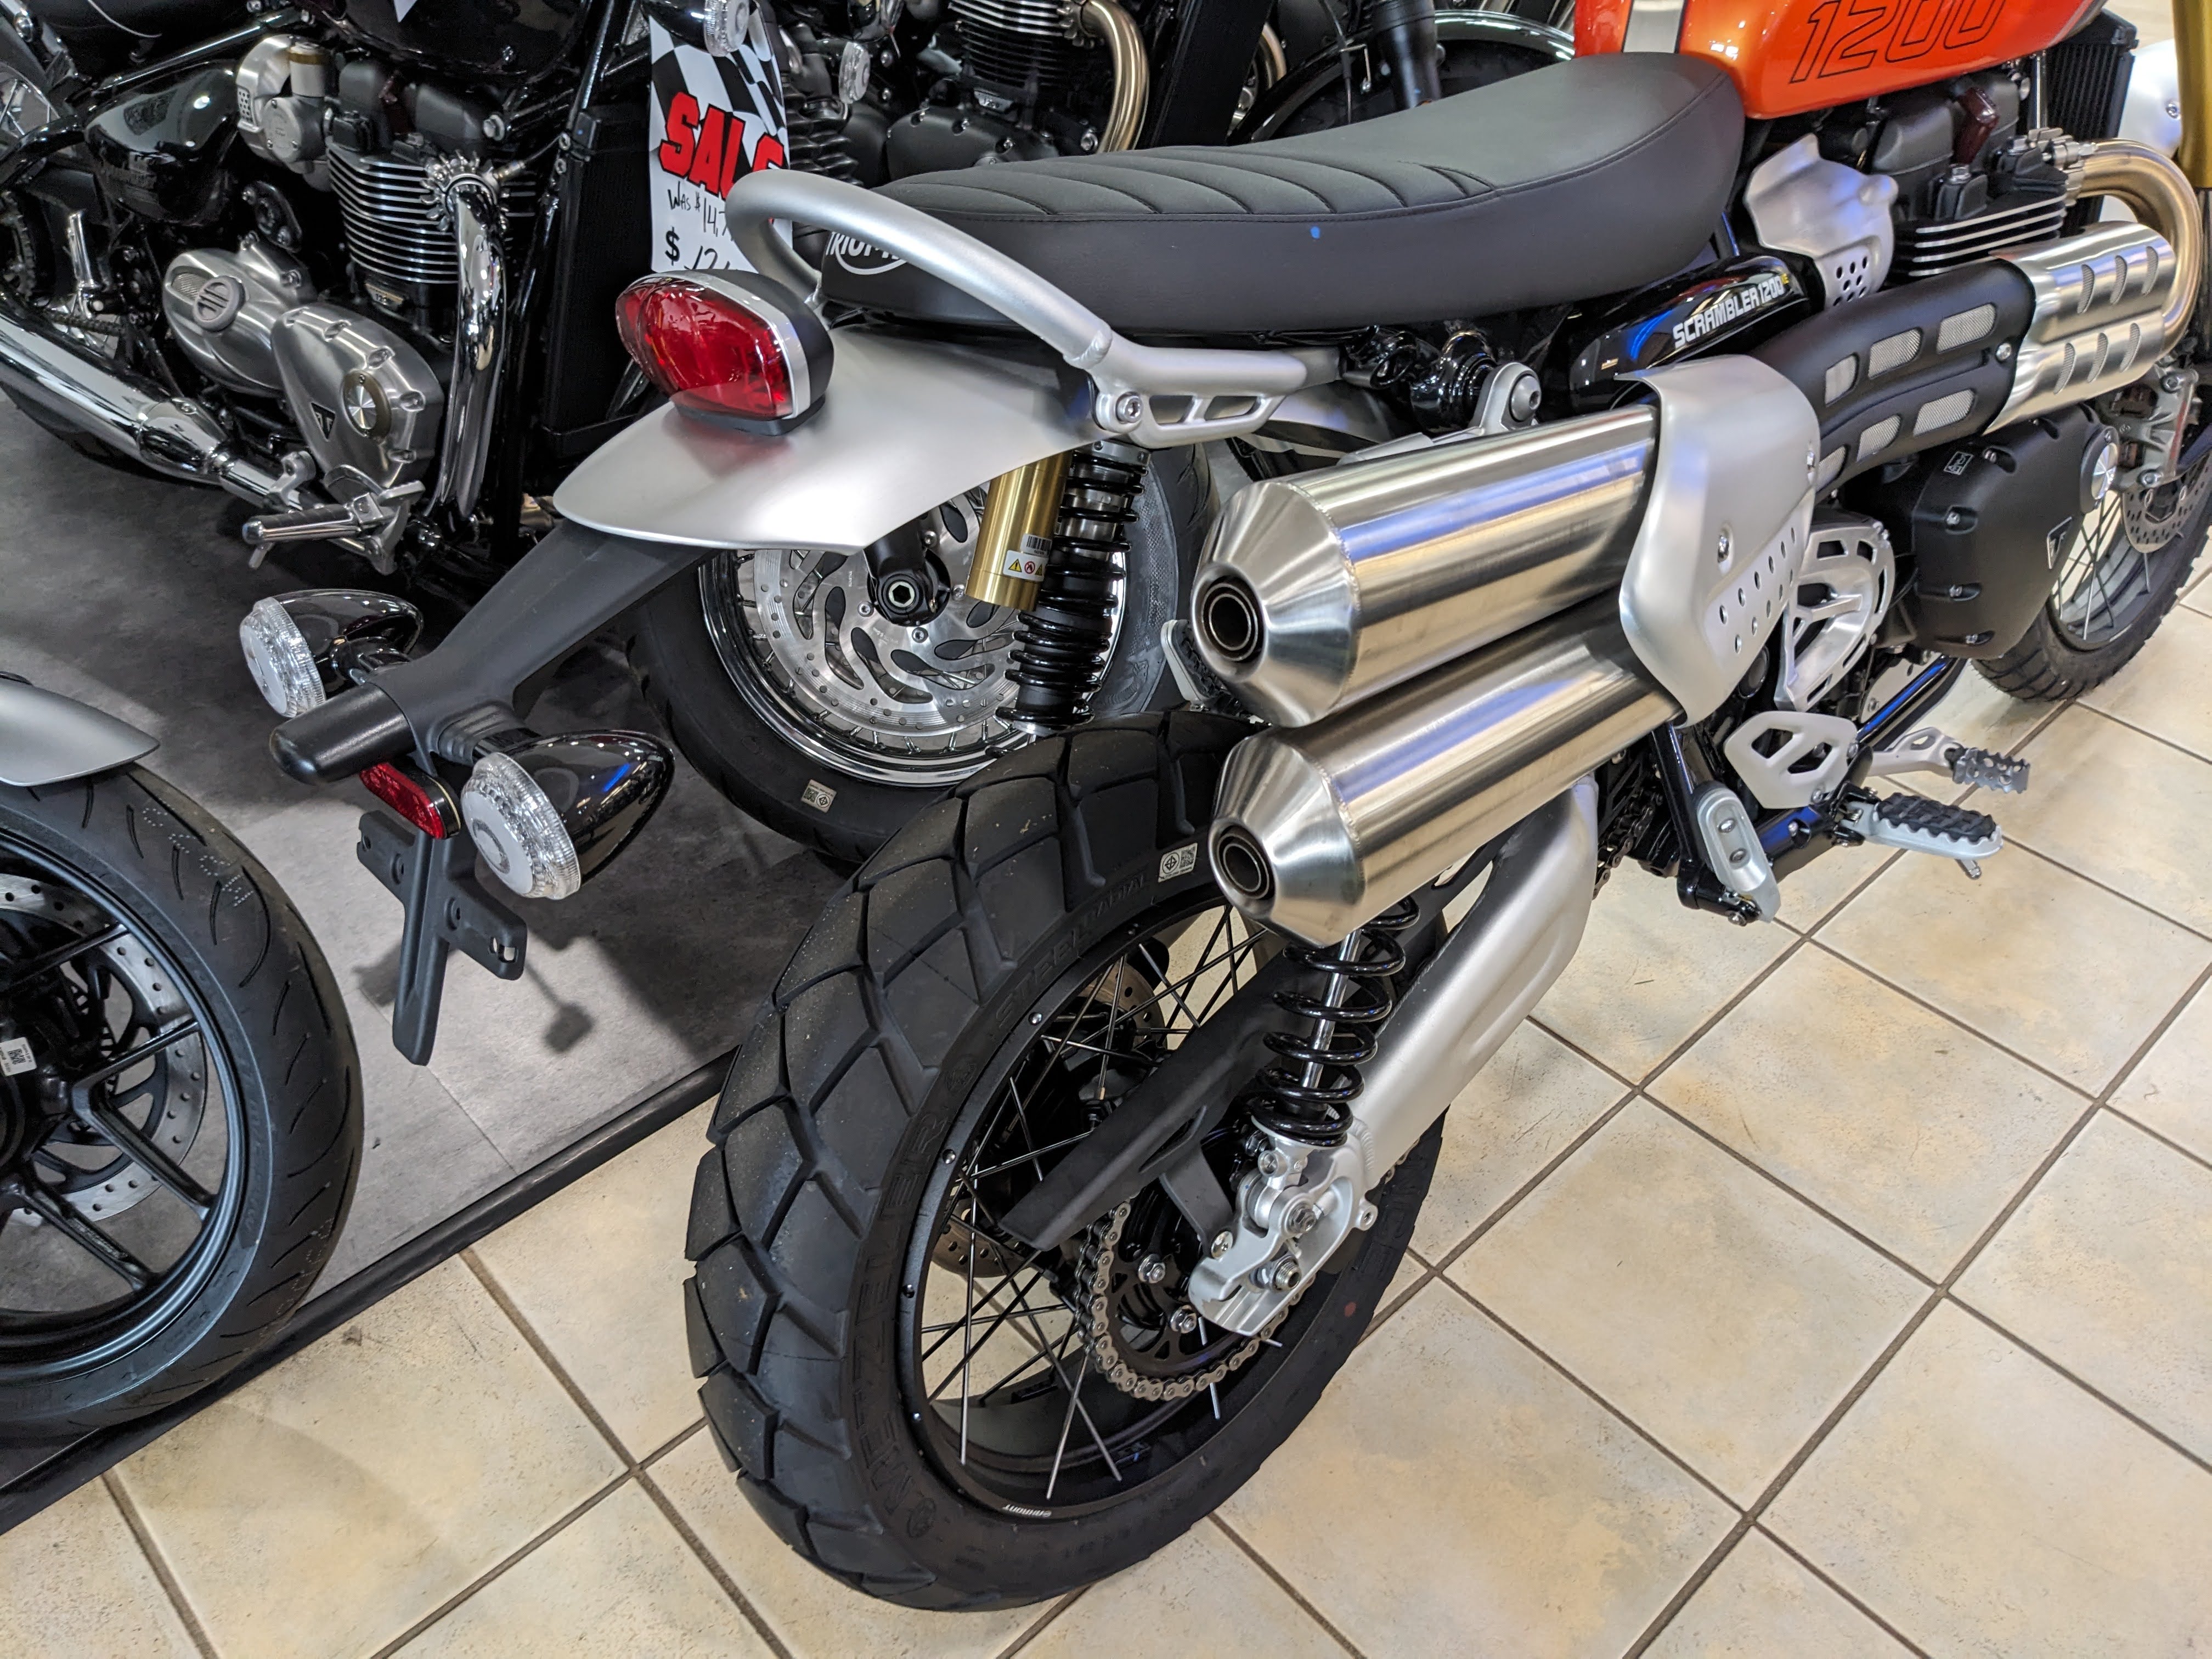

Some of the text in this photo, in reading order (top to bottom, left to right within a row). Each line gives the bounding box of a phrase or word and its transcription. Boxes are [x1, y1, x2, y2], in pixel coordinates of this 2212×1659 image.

[1789, 0, 2006, 83] 1200
[1673, 287, 1760, 349] SCRAMBLER
[1758, 275, 1785, 303] 1200
